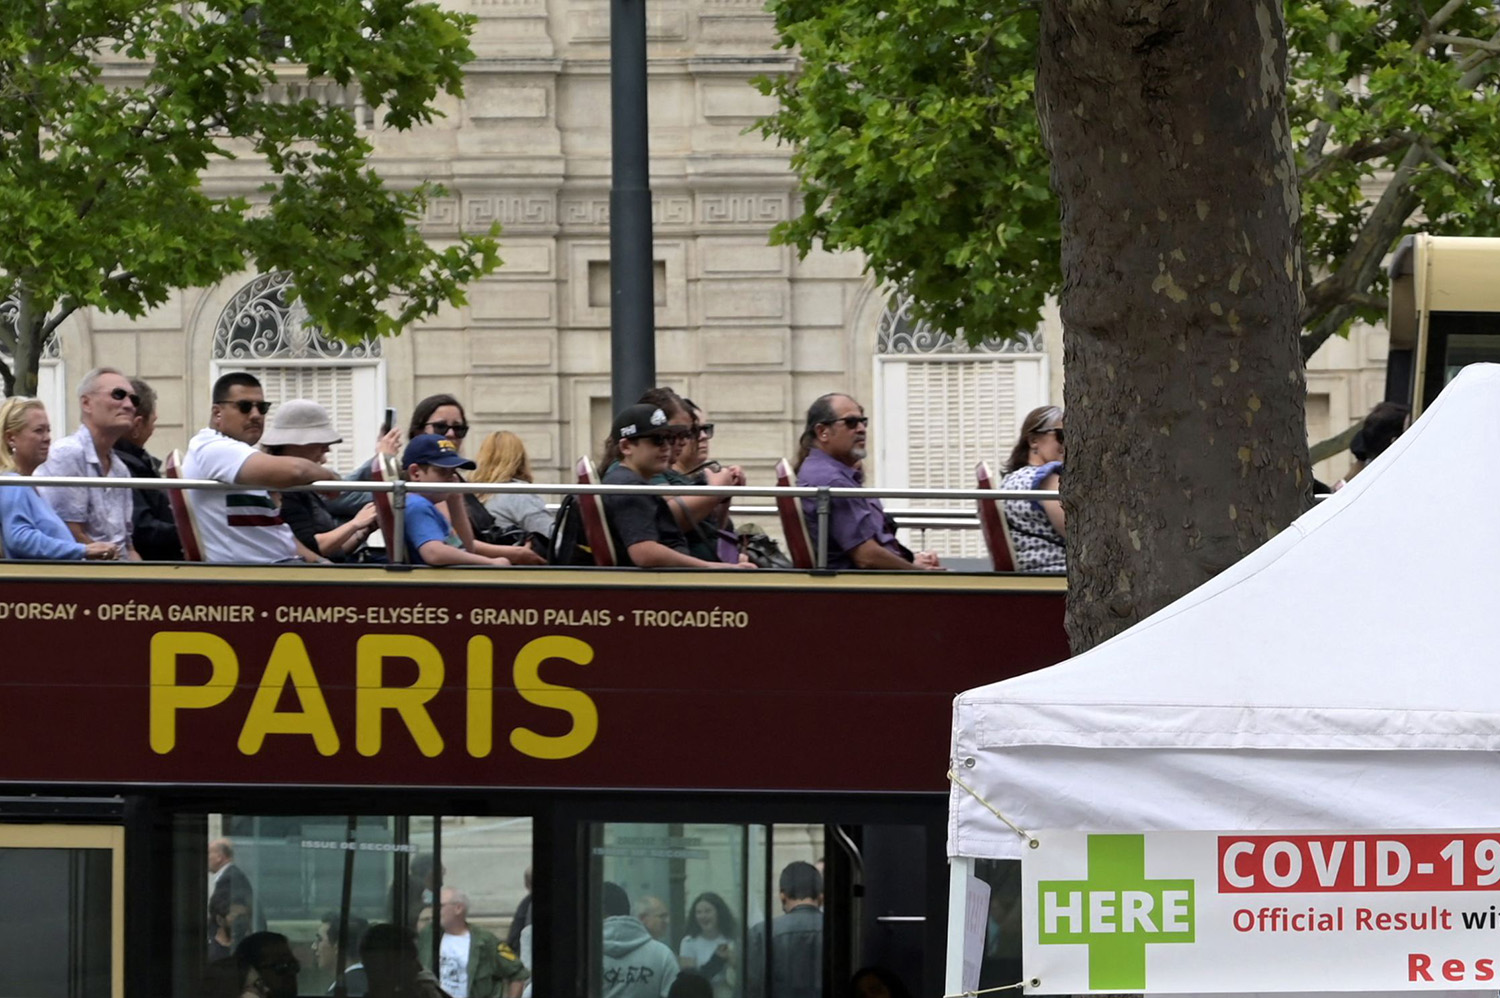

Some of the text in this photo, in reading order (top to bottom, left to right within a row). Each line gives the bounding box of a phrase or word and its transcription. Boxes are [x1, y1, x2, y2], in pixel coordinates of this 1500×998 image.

[97, 599, 165, 621] OPÉRA
[168, 604, 255, 622] GARNIER
[275, 602, 450, 624] CHAMPS-ELYSÉES
[470, 608, 539, 625] GRAND
[543, 609, 611, 626] PALAIS
[632, 606, 748, 628] TROCADÉRO
[150, 631, 599, 760] PARIS
[301, 840, 417, 852] ISSUE DE SECOURS
[1044, 889, 1191, 934] HERE
[1233, 906, 1343, 933] Official
[1356, 905, 1452, 931] Result
